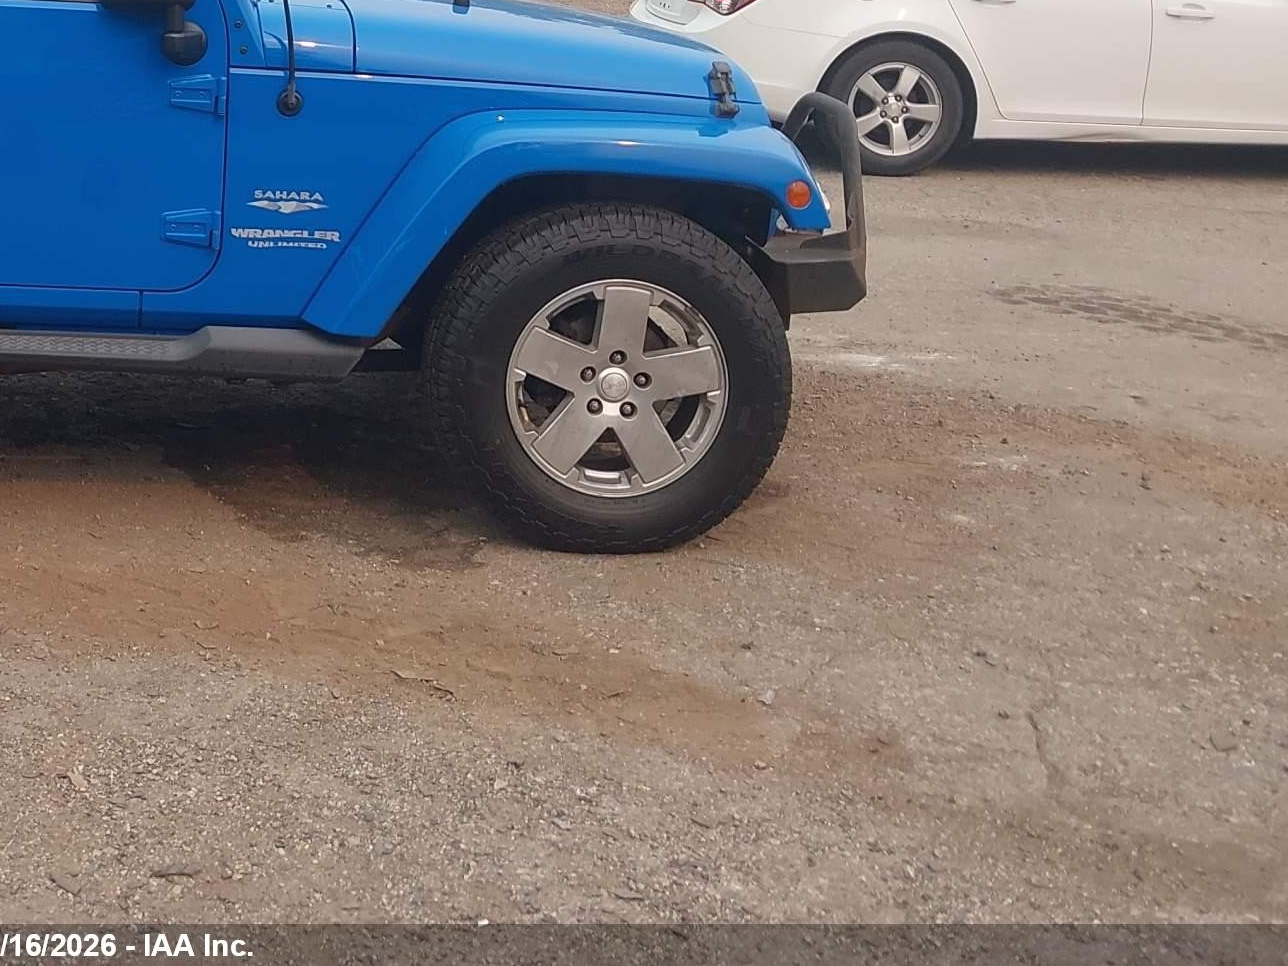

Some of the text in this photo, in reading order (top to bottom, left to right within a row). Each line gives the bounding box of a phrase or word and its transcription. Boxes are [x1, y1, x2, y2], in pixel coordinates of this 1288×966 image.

[253, 189, 324, 201] SAHARA
[231, 227, 341, 243] WRANGLER
[247, 240, 327, 249] UNLIMITED
